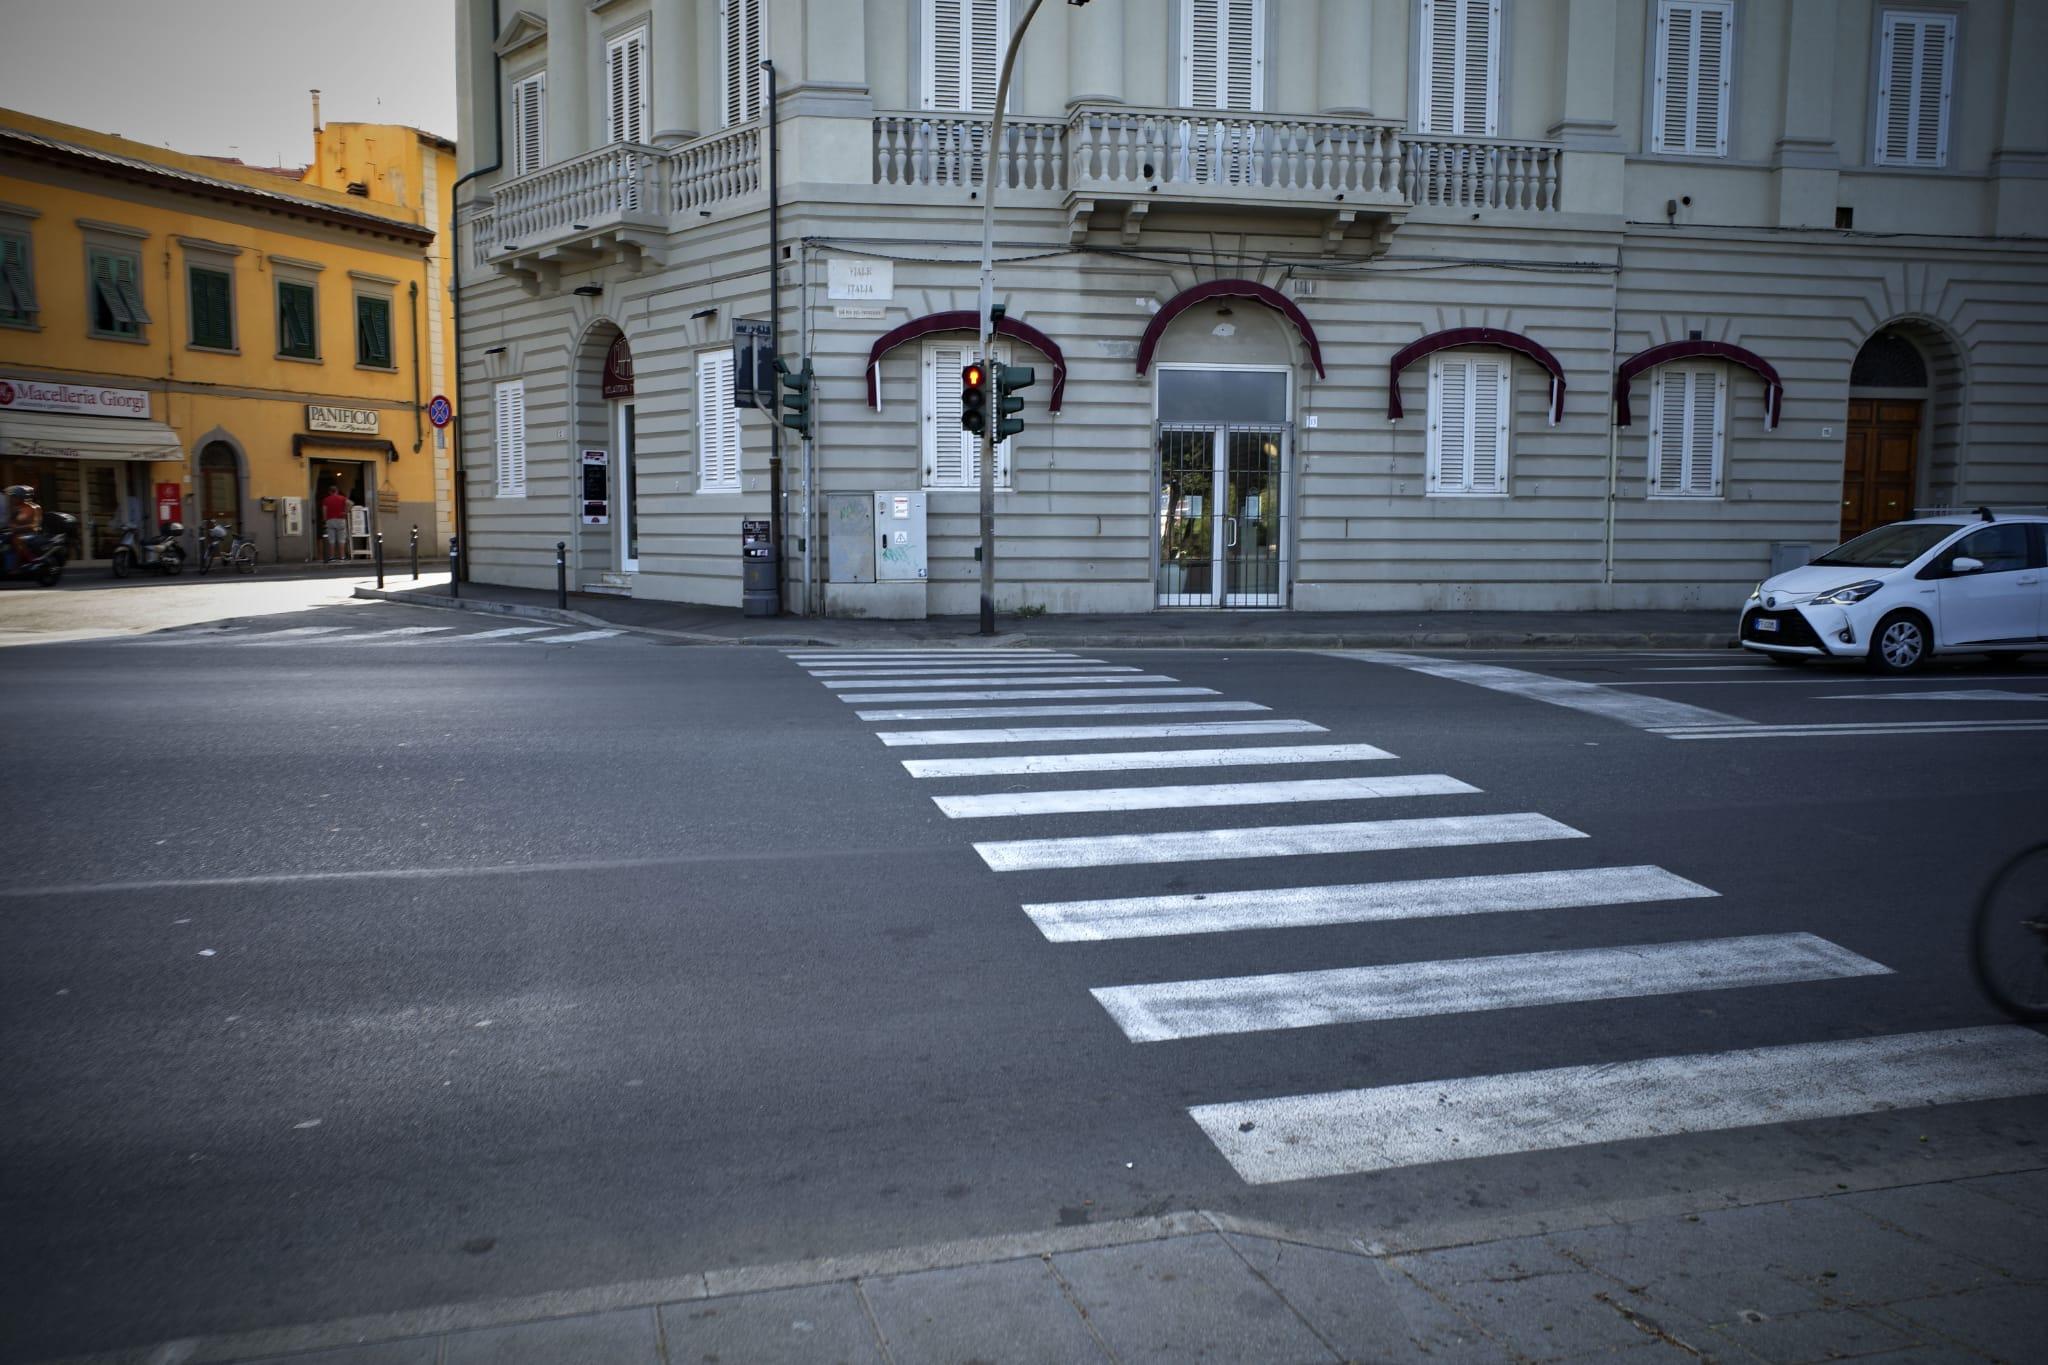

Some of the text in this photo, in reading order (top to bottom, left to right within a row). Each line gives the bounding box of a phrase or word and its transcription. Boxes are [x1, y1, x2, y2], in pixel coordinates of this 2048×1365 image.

[847, 284, 873, 295] ITALIA
[16, 383, 97, 405] Macelleria
[100, 390, 146, 413] Giorgi
[311, 406, 377, 426] PANIFICIO
